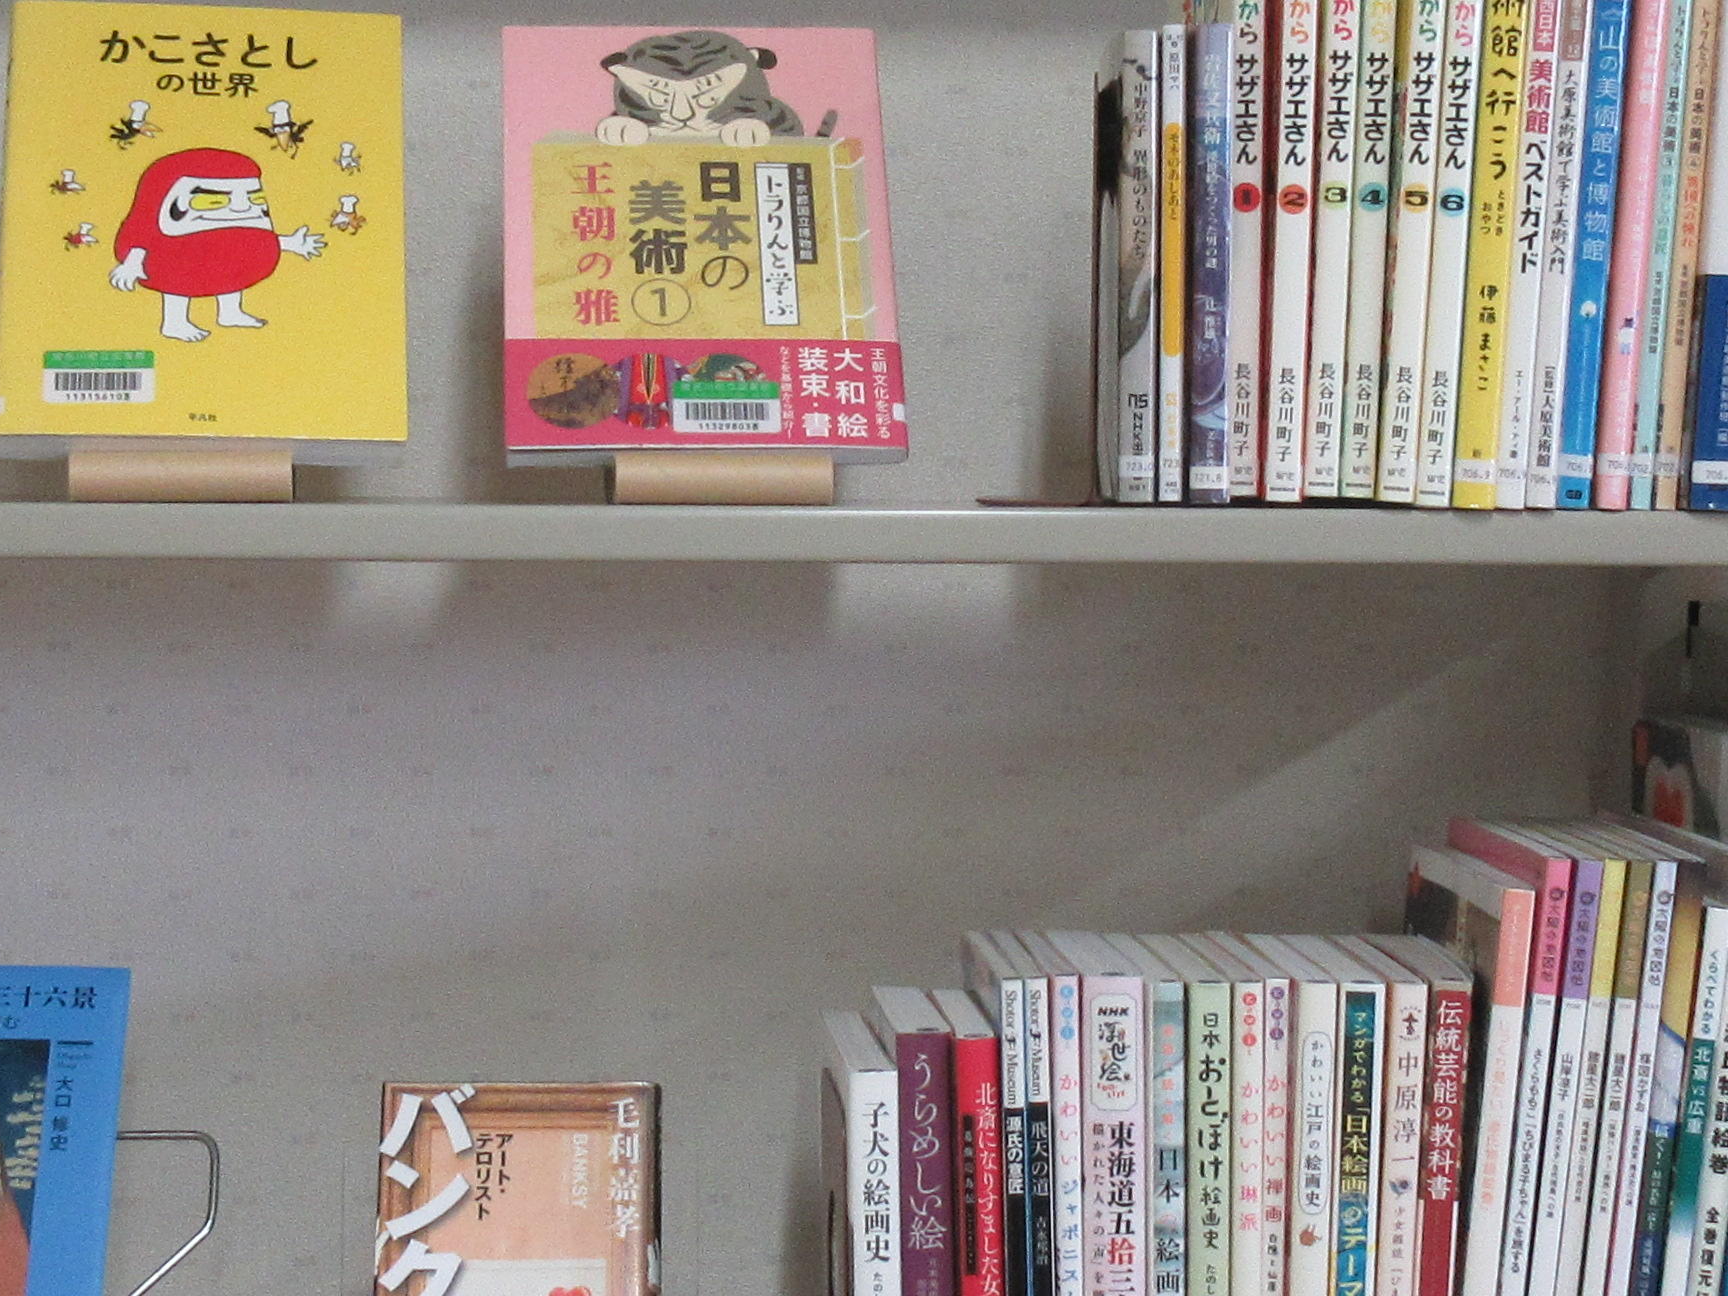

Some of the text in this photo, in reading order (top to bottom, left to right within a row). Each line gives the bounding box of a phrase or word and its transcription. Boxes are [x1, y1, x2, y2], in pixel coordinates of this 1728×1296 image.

[100, 31, 318, 69] かこさとし
[157, 73, 259, 97] の世界
[1234, 54, 1260, 164] サザエさん
[1284, 54, 1309, 167] サザエさん
[1327, 50, 1352, 163] サザエさん
[1364, 52, 1390, 165] サザエさん
[1408, 52, 1436, 166] サザエさん
[1444, 57, 1472, 170] サザエさん
[1133, 83, 1147, 259] 中野京子 異形のものたち
[1285, 191, 1302, 205] 2
[1323, 186, 1348, 203] 3
[1360, 189, 1386, 205] 4
[1404, 190, 1428, 206] 5
[1440, 194, 1465, 211] 6
[1519, 59, 1555, 275] 美術館ベストガイド
[571, 161, 620, 326] 王朝の雅
[694, 161, 753, 291] 日本の
[798, 348, 832, 437] 装束・書
[834, 348, 868, 437] 大和絵
[1233, 363, 1251, 457] 長谷川町子
[1278, 367, 1296, 462] 長谷川町子
[1315, 362, 1334, 458] 長谷川町子
[1353, 363, 1373, 458] 長谷川町子
[1392, 366, 1413, 459] 長谷川町子
[1428, 371, 1448, 464] 長谷川町子
[1098, 1007, 1129, 1016] NHK
[1006, 1053, 1016, 1105] Museum
[1029, 1045, 1040, 1097] Museum
[1392, 1051, 1418, 1163] 中原淳一
[1427, 1000, 1465, 1201] 伝統芸能の教科書
[571, 1135, 587, 1207] BANKSY
[908, 1054, 947, 1250] うらめしい絵
[1031, 1123, 1050, 1197] 飛天の道
[1198, 1013, 1228, 1249] 日本おとぼけ絵画史
[1240, 1083, 1259, 1231] かわいい琳派
[1265, 1077, 1286, 1223] かわいい禅画
[1303, 1041, 1324, 1207] かわいい江戸の絵画史
[475, 1134, 495, 1221] テロリスト
[862, 1102, 890, 1263] 子犬の絵画史
[975, 1083, 1000, 1296] 北斎になりすました女
[1155, 1149, 1180, 1294] 日本の絵画
